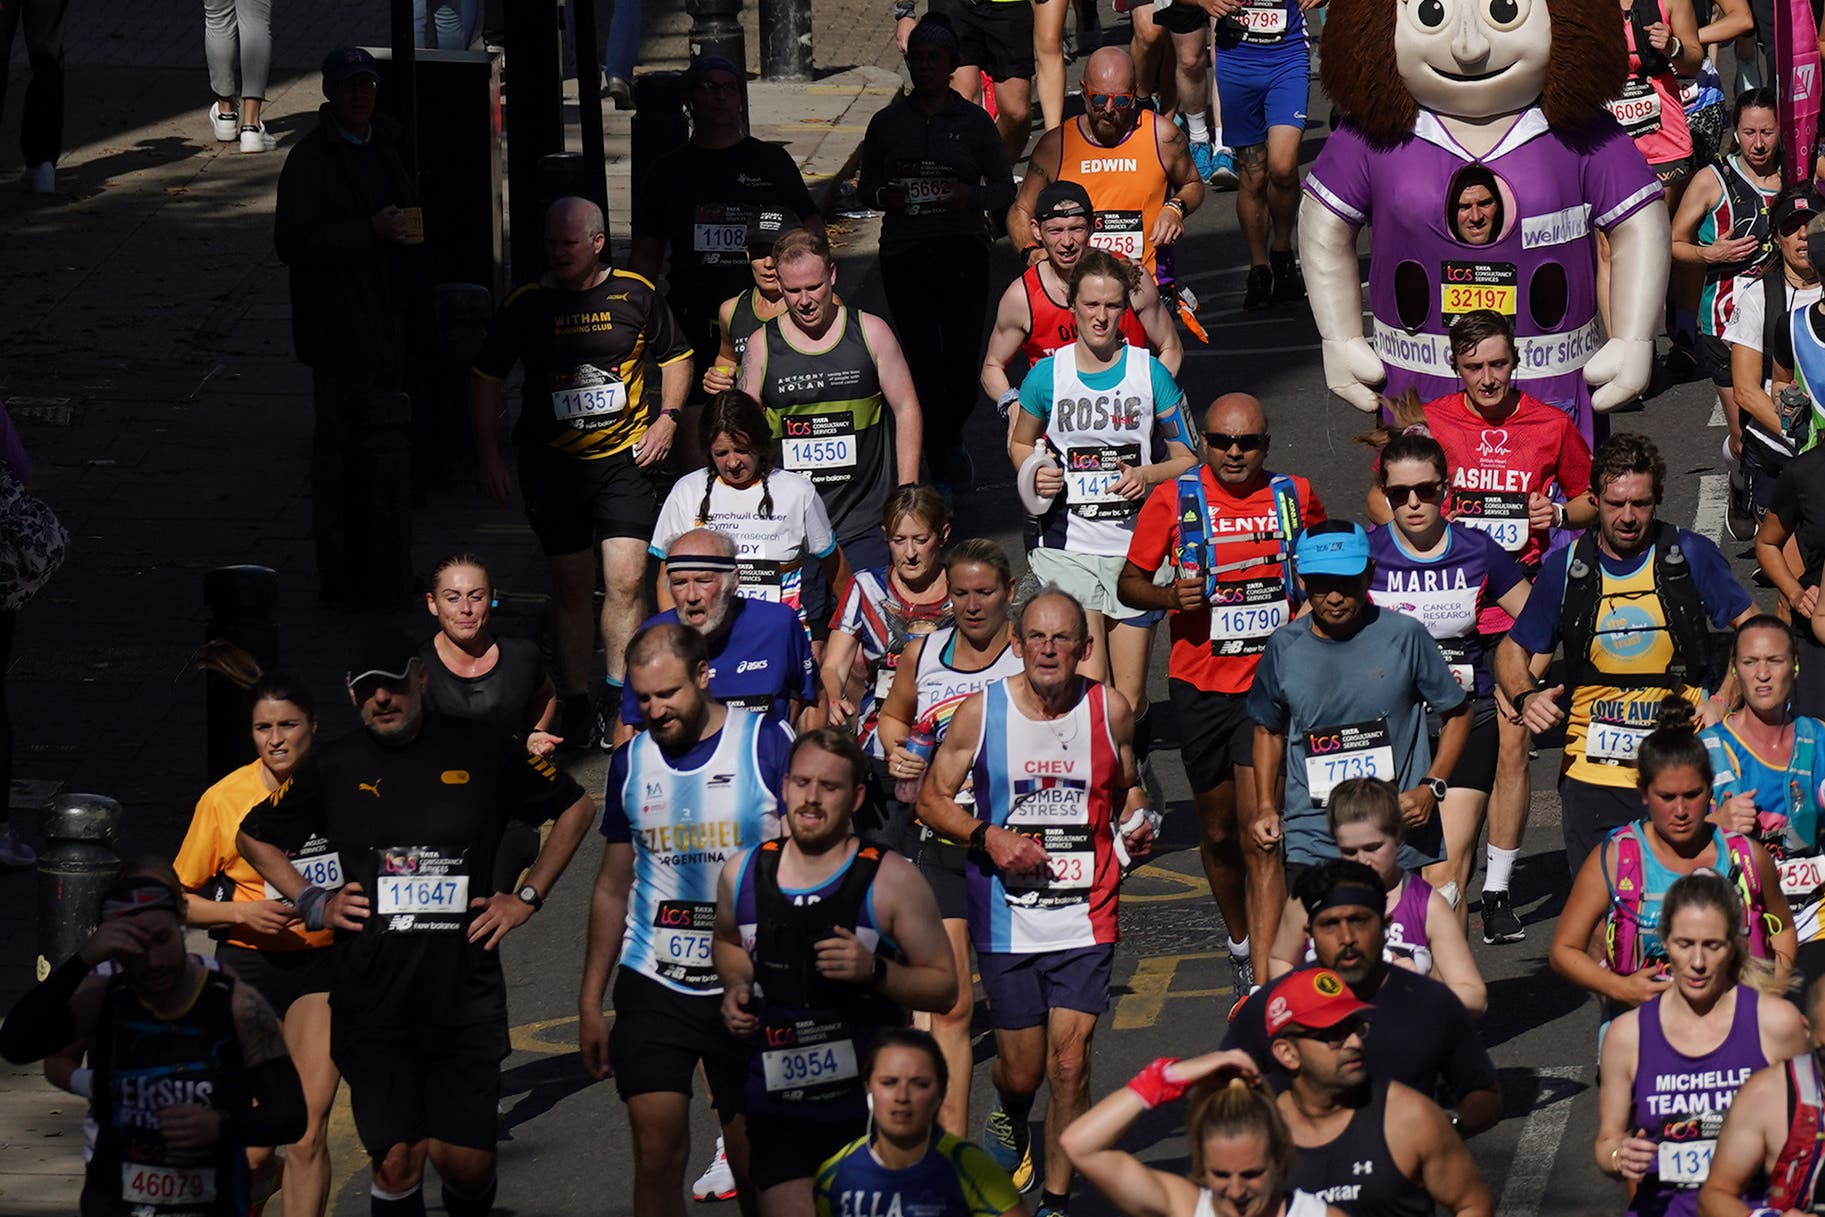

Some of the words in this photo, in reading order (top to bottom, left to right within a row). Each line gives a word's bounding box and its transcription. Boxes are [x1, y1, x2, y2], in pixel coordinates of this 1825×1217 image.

[1080, 158, 1137, 174] EDWIN
[1447, 265, 1473, 282] tcs
[1450, 288, 1507, 309] 32197
[554, 311, 612, 326] WITHAM
[592, 324, 613, 332] CLUB
[1378, 335, 1437, 365] national
[1524, 341, 1553, 367] for
[1557, 335, 1583, 360] sick
[777, 372, 824, 384] ANTHONY
[778, 380, 824, 393] NOLAN
[562, 389, 616, 414] 11357
[787, 419, 812, 436] tcs
[812, 421, 850, 430] CONSULTANCY
[792, 441, 847, 462] 14550
[1453, 467, 1532, 492] ASHLEY
[1456, 496, 1482, 515] tcs
[709, 522, 740, 531] cymru
[1387, 567, 1468, 593] MARIA
[1216, 585, 1244, 604] tcs
[1423, 603, 1462, 612] CANCER
[1423, 610, 1471, 620] RESEARCH
[1220, 606, 1281, 633] 16790
[1310, 734, 1341, 754] tcs
[1024, 760, 1075, 774] CHEV
[1325, 756, 1377, 782] 7735
[1014, 790, 1084, 805] COMBAT
[1018, 804, 1078, 816] STRESS
[385, 852, 418, 872] tcs
[390, 882, 458, 905] 11647
[660, 905, 691, 926] tcs
[781, 1048, 837, 1080] 3954
[1646, 1092, 1711, 1116] TEAM
[131, 1170, 205, 1198] 46079
